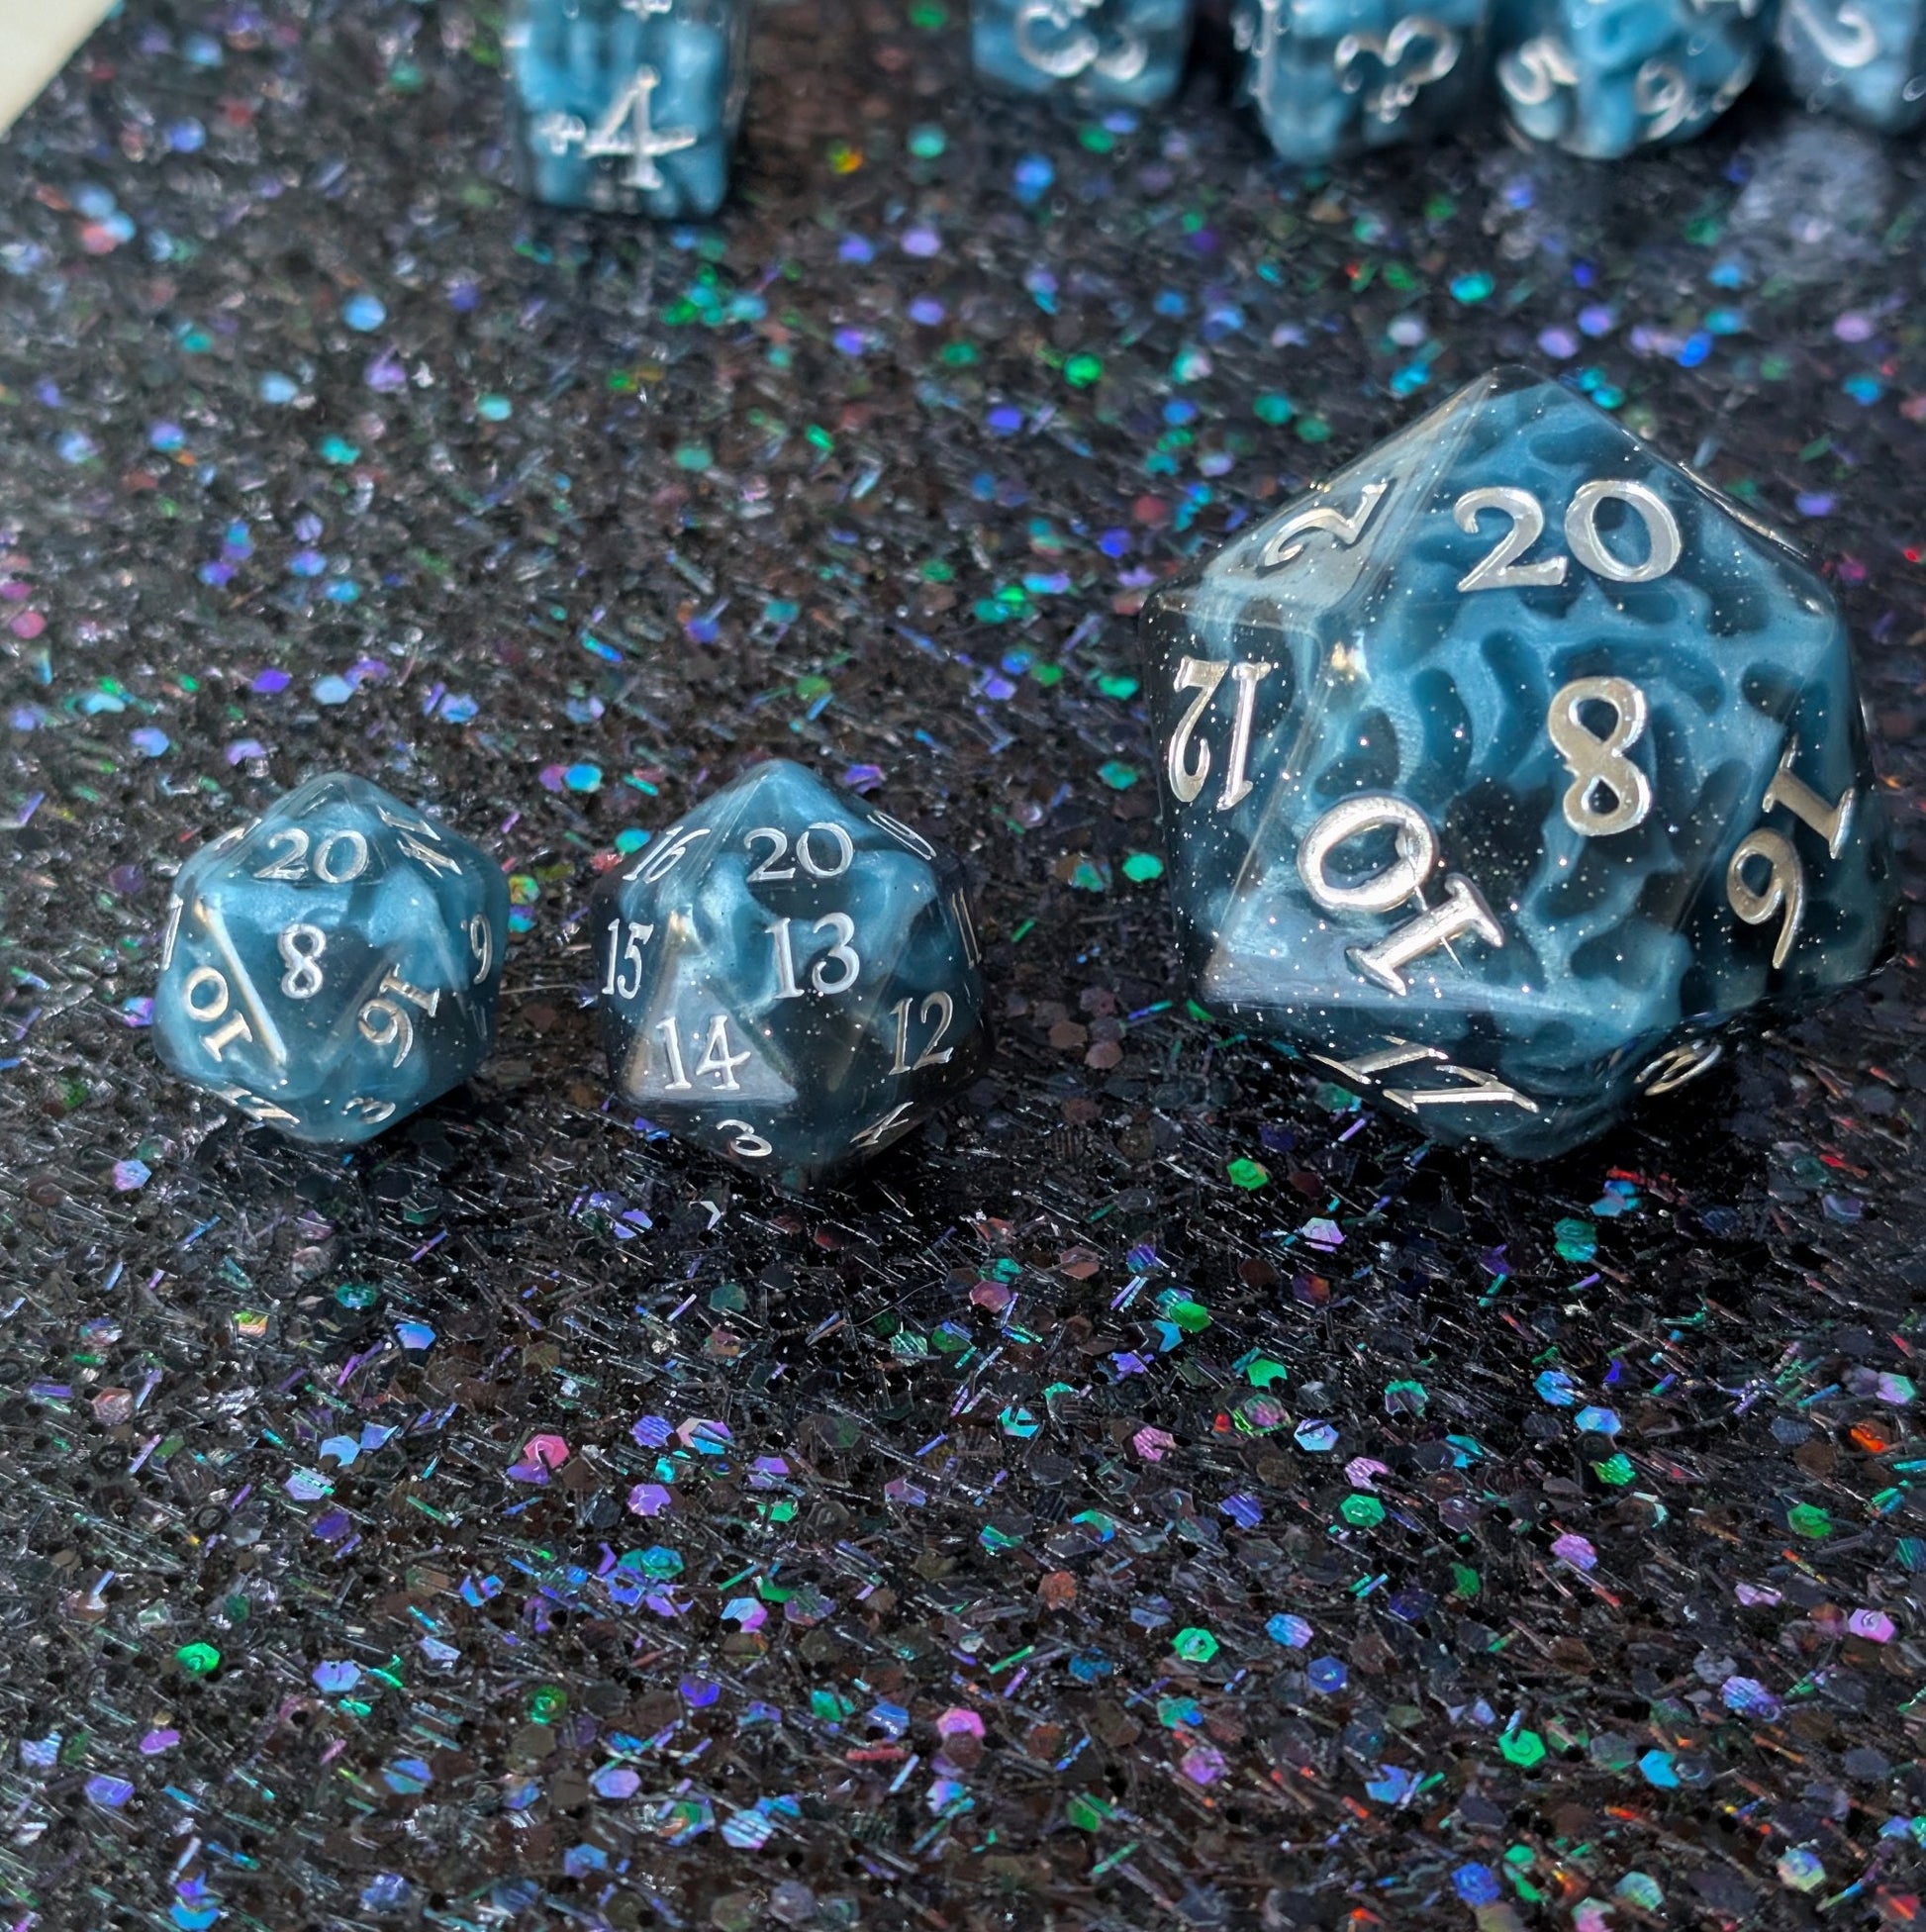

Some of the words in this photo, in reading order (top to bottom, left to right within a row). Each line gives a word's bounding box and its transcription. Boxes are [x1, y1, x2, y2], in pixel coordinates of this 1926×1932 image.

[1453, 478, 1683, 593] 20
[1167, 653, 1272, 812] 12
[1547, 675, 1652, 837] 8
[252, 827, 370, 884] 20
[622, 824, 712, 884] 16
[742, 821, 855, 884] 20
[1298, 796, 1505, 998] 10
[277, 922, 327, 1001] 8
[601, 918, 655, 1000] 15
[764, 911, 860, 1000] 13
[181, 965, 254, 1063] 10
[655, 1014, 752, 1091] 14
[888, 990, 955, 1076] 12
[715, 1118, 773, 1158] 3
